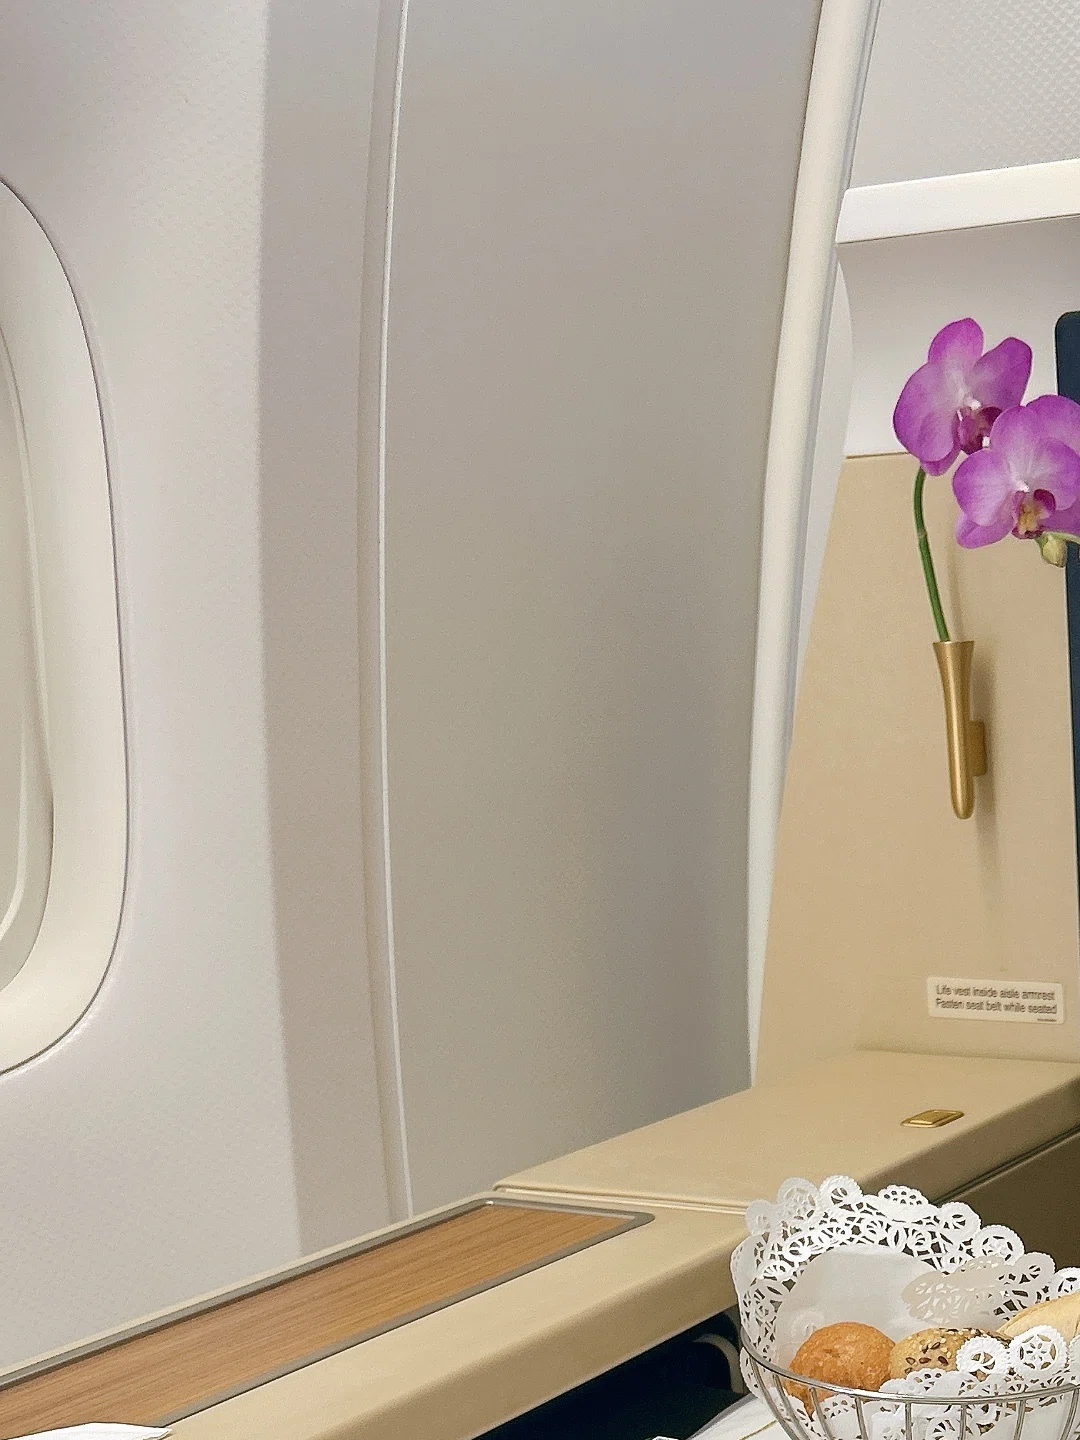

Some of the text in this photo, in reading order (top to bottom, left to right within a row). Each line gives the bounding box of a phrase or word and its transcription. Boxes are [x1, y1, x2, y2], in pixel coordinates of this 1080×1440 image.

[936, 985, 1055, 1000] Life vest inside aisle armrest
[936, 998, 1057, 1014] Fasten seat belt while seated
